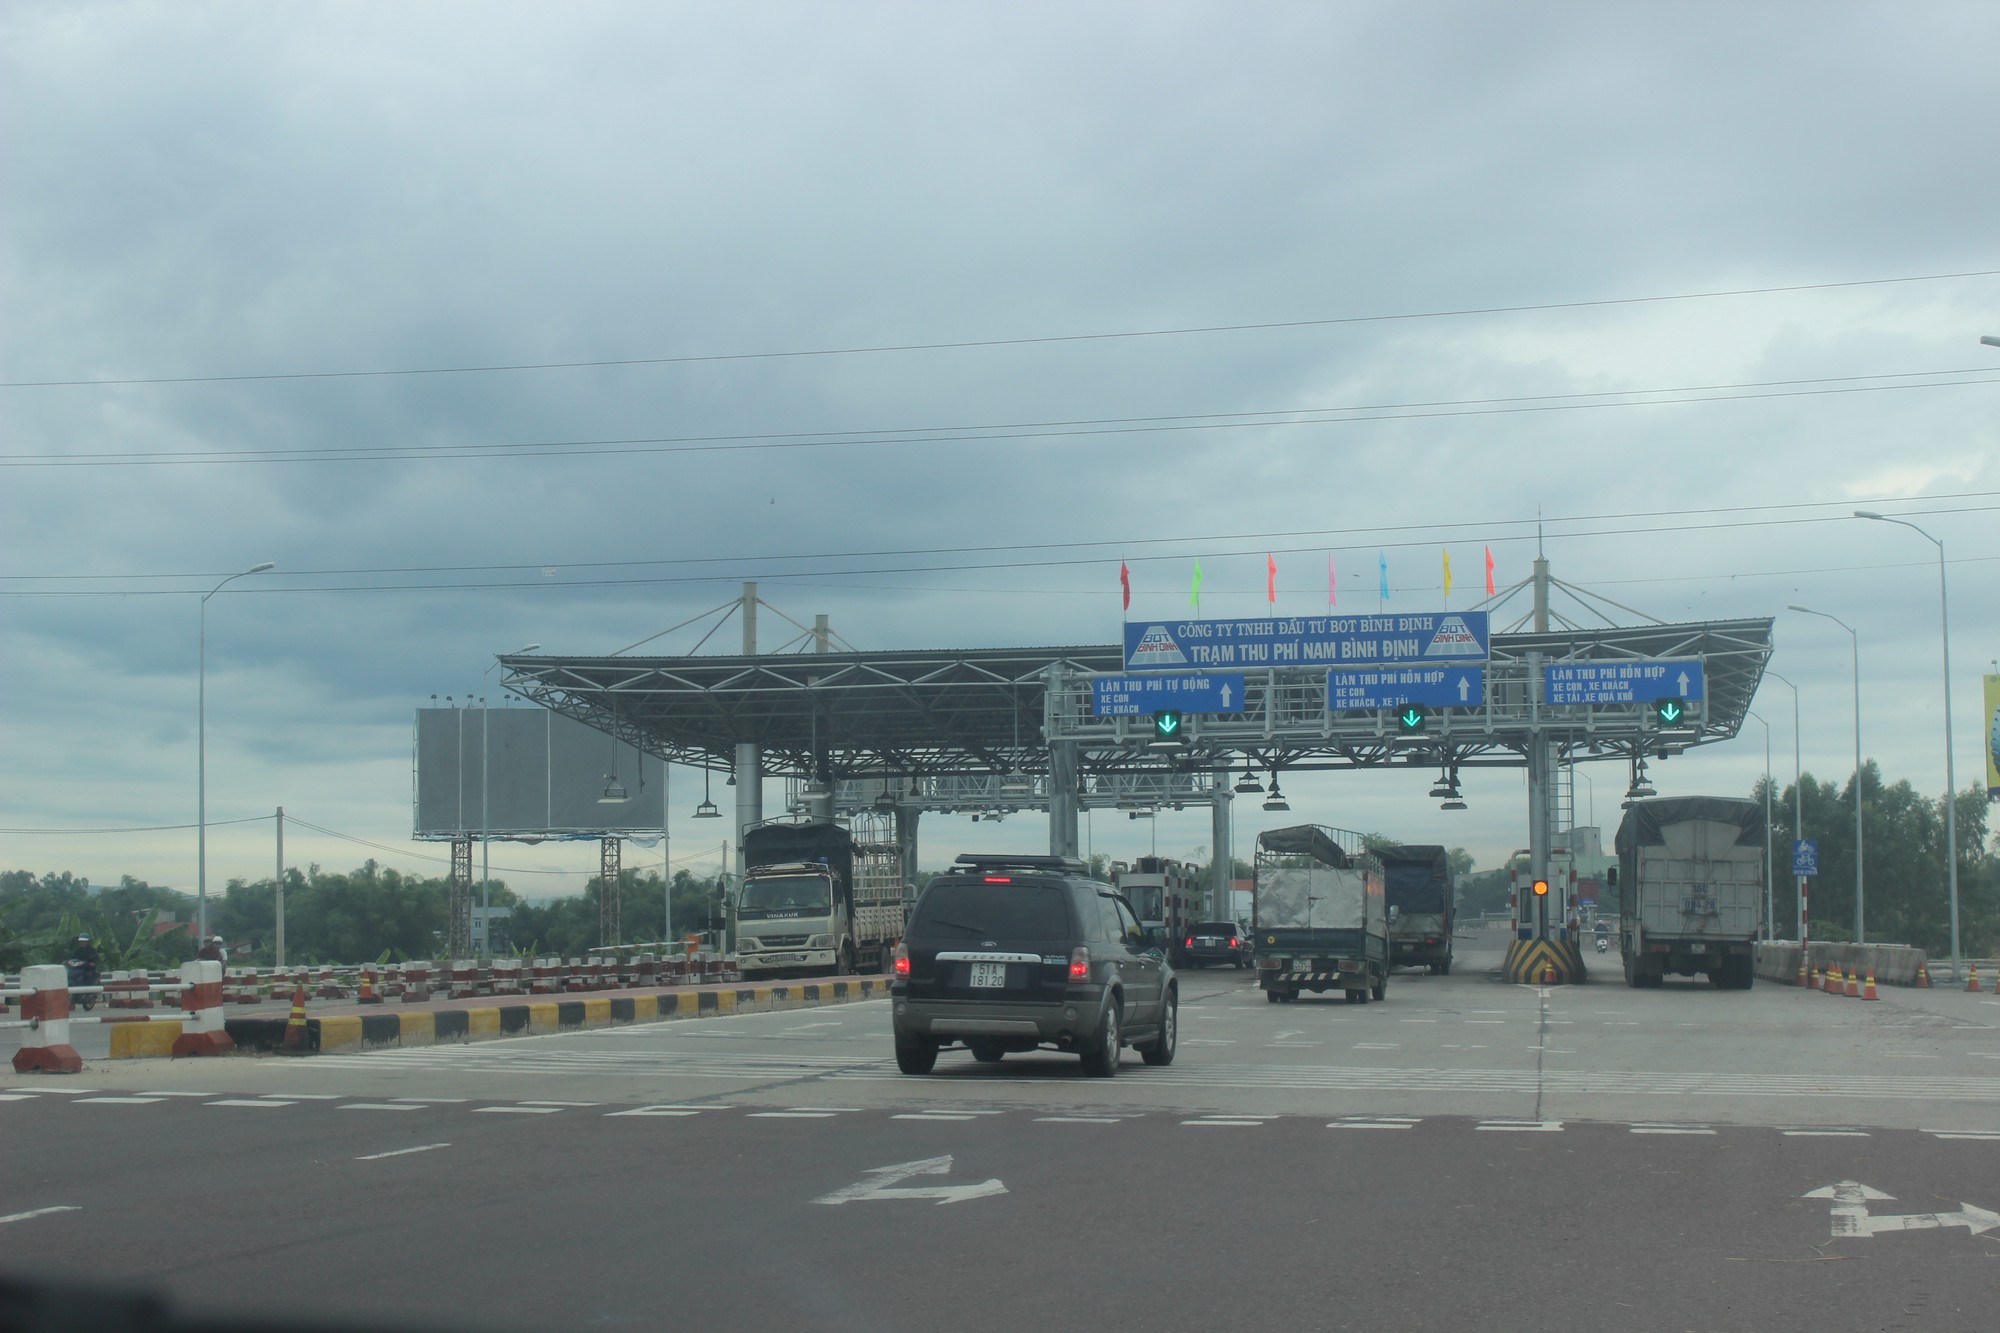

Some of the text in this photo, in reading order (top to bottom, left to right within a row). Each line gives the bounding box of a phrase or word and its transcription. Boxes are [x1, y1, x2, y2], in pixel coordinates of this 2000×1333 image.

[1178, 615, 1434, 638] CÔNG TY TNHH ĐẦU TƯ BOT BÌNH ĐỊNH
[1438, 624, 1466, 634] BOT
[1142, 633, 1170, 643] BOT
[1190, 637, 1419, 666] TRẠM THU PHÍ NAM BÌNH ĐỊNH
[1336, 669, 1445, 686] LÀN THU PHÍ HỖN HỢP
[1552, 664, 1666, 680] LÀN THU PHÍ HỖN HỢP
[1100, 676, 1210, 693] LÀN THU PHÍ TỰ ĐỘNG
[1553, 682, 1564, 692] XE
[1589, 681, 1600, 691] XE
[1602, 680, 1629, 690] KHÁCH
[1336, 688, 1365, 697] XE CON
[1554, 694, 1565, 703] XE
[1598, 690, 1614, 703] QUÁ
[1101, 694, 1129, 704] XE CON
[1336, 699, 1347, 708] XE
[1382, 698, 1393, 707] XE
[1101, 703, 1139, 714] XE KHÁCH
[979, 965, 997, 976] 51A
[972, 976, 1004, 987] 181.20
